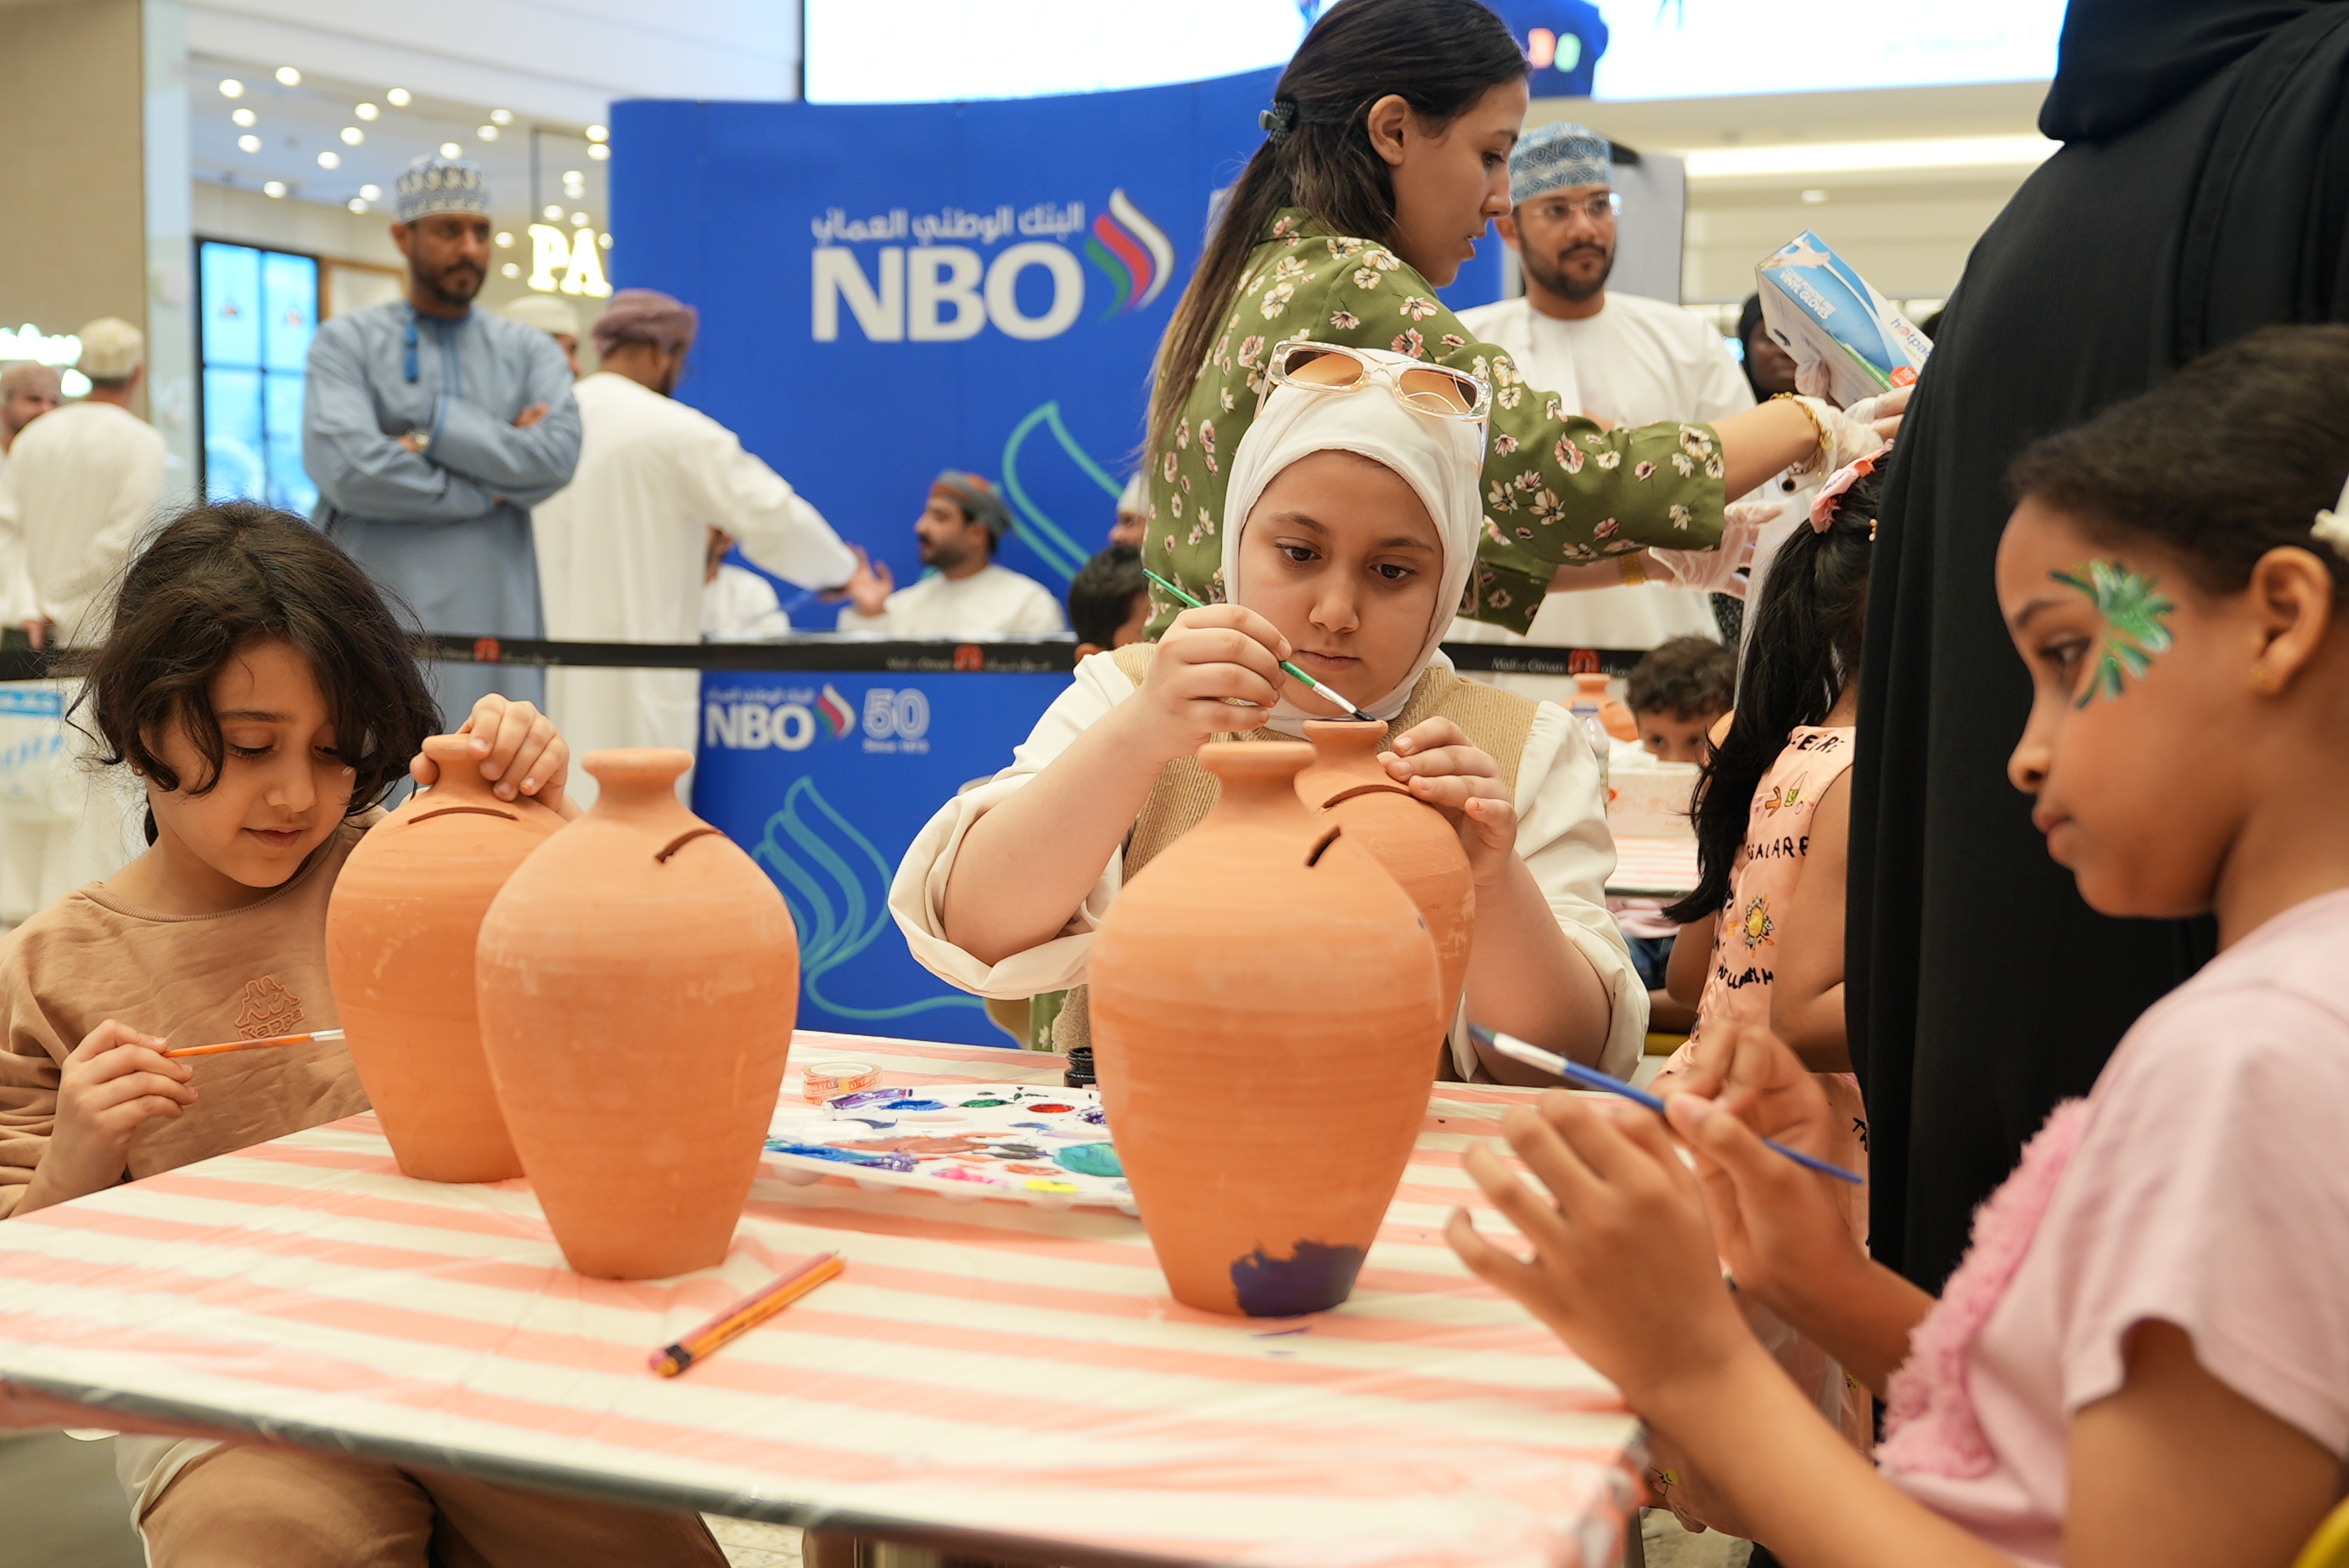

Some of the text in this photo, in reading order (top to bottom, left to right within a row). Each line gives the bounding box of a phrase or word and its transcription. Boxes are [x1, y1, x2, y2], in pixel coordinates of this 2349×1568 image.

[811, 201, 1085, 246] البنك الوطني العماني
[811, 241, 1085, 343] NBO
[1798, 289, 1830, 320] GLOVES
[1491, 658, 1517, 671] Mall
[1528, 658, 1564, 673] Oman
[705, 703, 816, 752] NBO
[861, 687, 931, 740] 50
